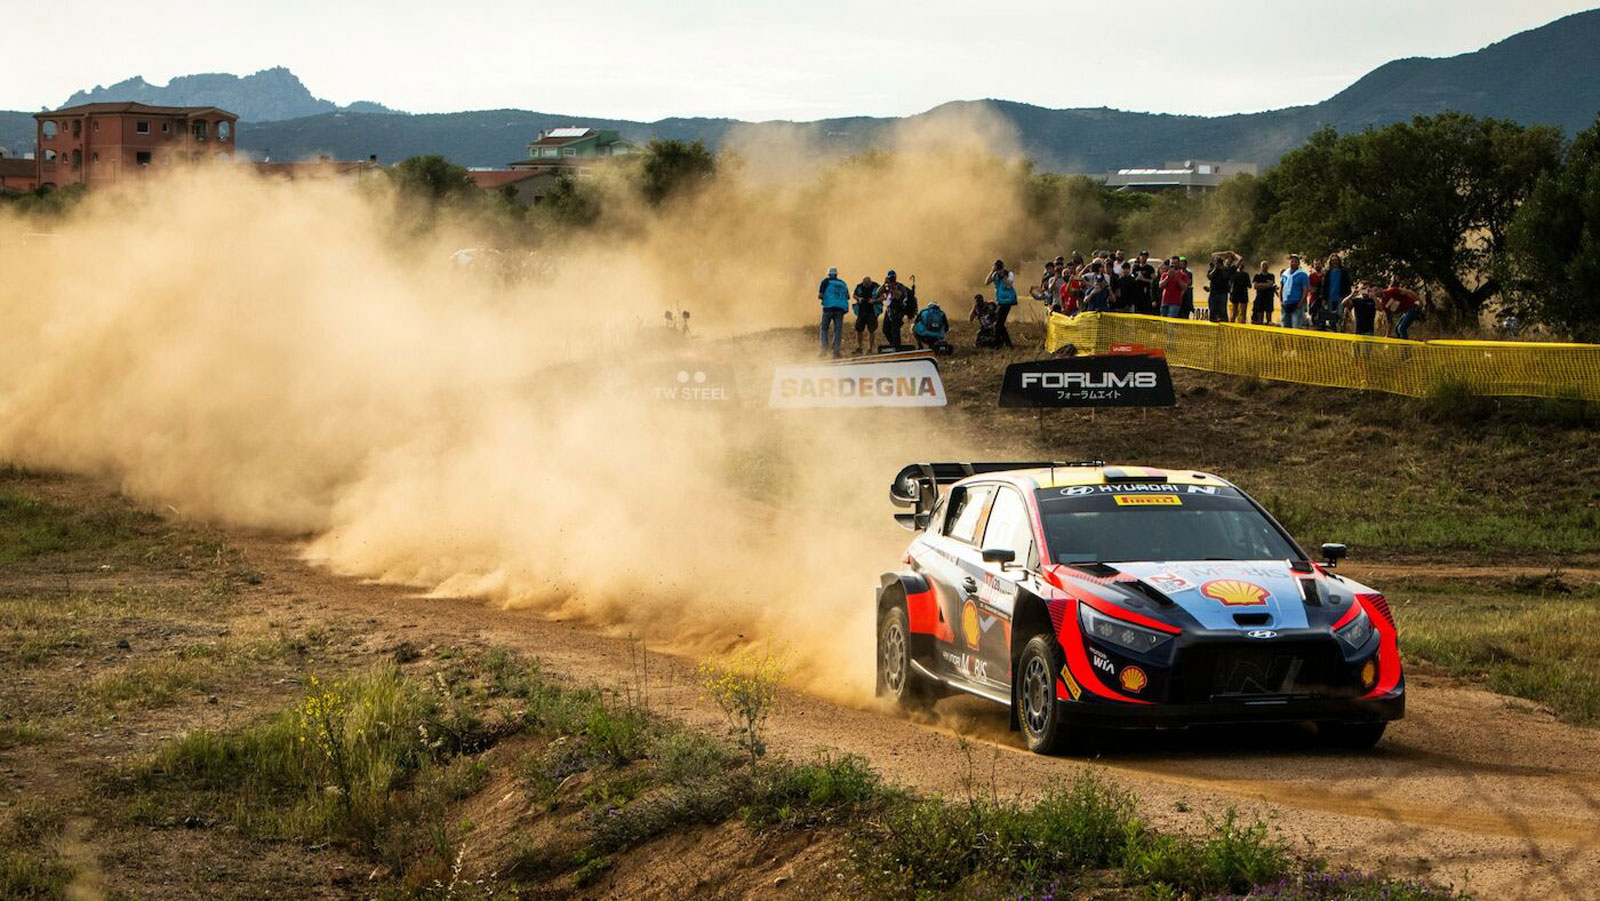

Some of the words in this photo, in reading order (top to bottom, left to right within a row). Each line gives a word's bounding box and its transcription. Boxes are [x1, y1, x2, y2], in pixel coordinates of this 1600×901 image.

[1021, 372, 1157, 389] FORUM8
[780, 376, 937, 397] SARDEGNA
[653, 387, 678, 399] TW
[681, 387, 729, 400] STEEL
[1056, 390, 1121, 400] フォーラムエイト
[1098, 484, 1179, 493] HYUNDAI
[1121, 496, 1175, 504] PIRELLI
